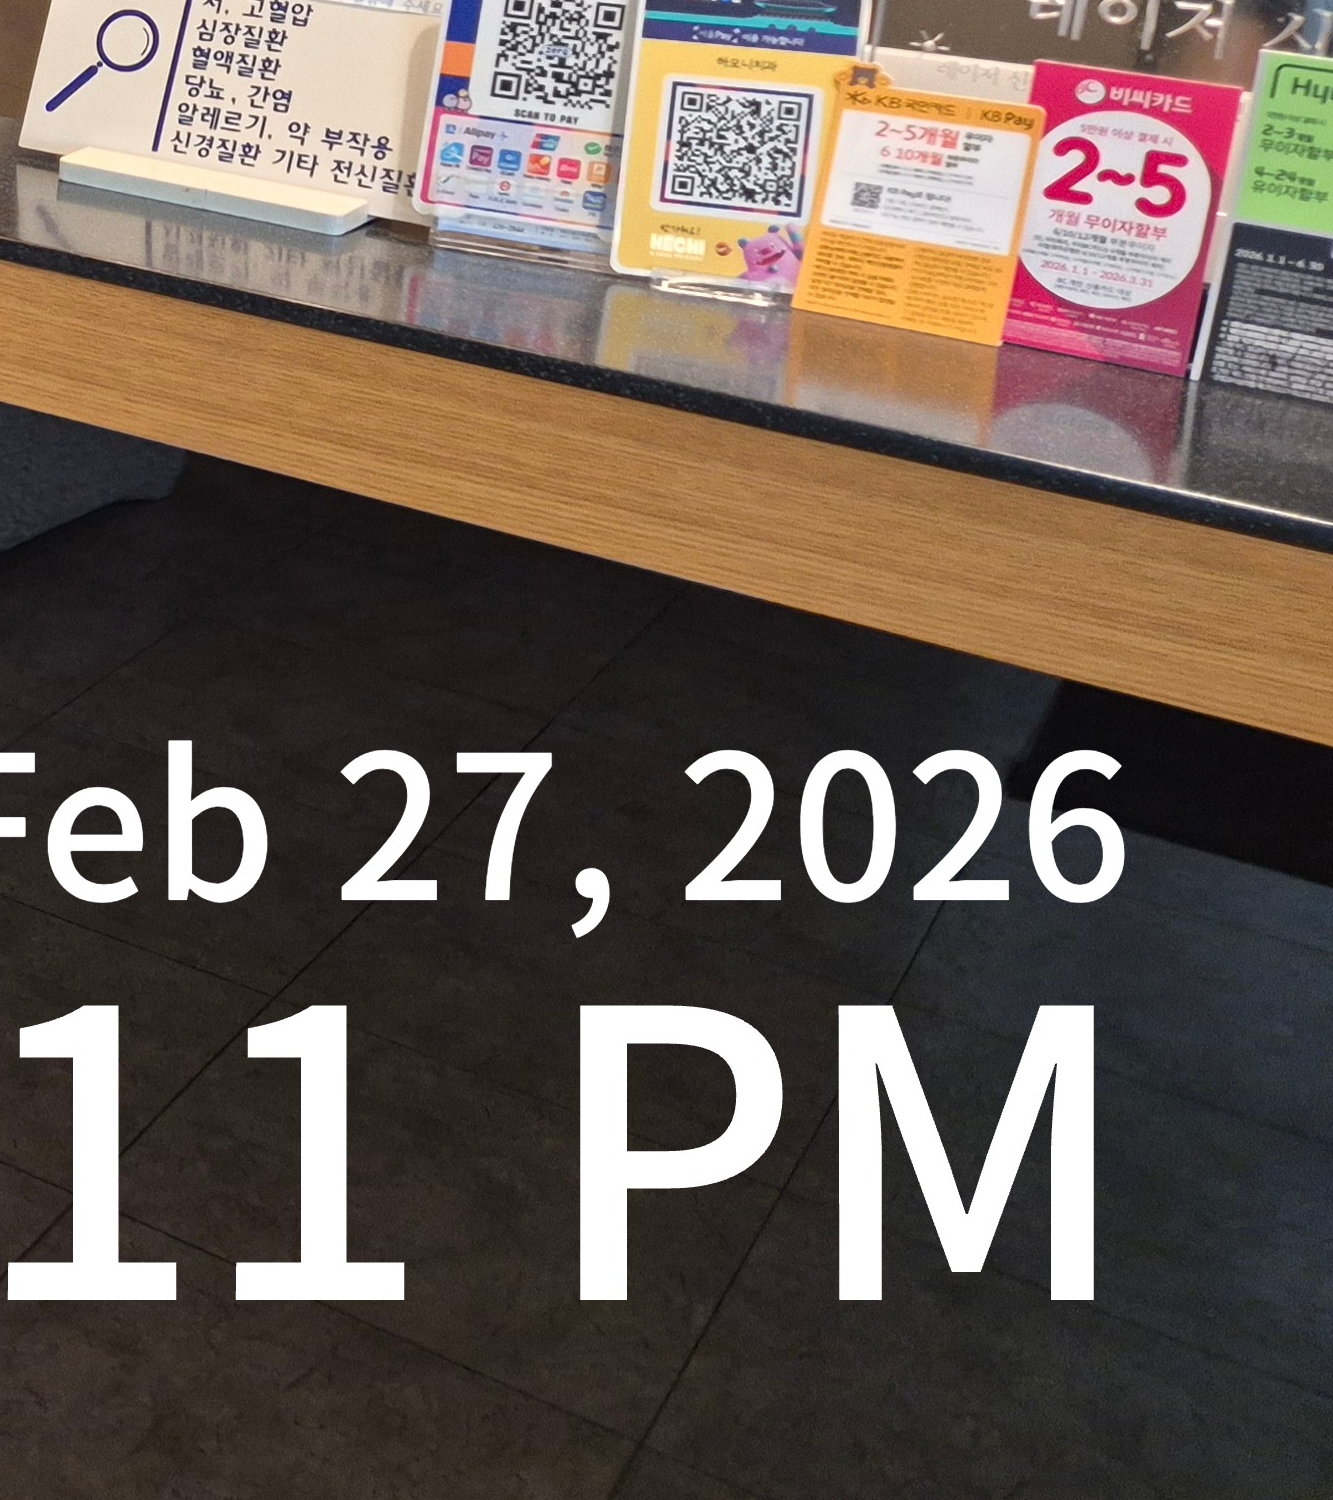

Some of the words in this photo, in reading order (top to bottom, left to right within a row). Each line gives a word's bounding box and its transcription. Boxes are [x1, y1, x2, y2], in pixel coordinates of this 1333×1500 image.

[195, 18, 289, 53] 심장질환
[191, 46, 282, 82] 혈액질환
[248, 83, 294, 114] 간염
[1109, 86, 1193, 114] 비씨카드
[513, 108, 541, 121] SCAN
[544, 112, 557, 122] TO
[559, 114, 580, 126] PAY
[1002, 111, 1035, 131] Pay
[287, 120, 312, 145] 약
[320, 127, 394, 161] 부작용
[874, 119, 960, 151] 2~5개월
[169, 132, 263, 168] 신경질환
[273, 148, 320, 178] 기타
[1043, 135, 1190, 219] 2~5
[1048, 208, 1081, 227] 개월
[1084, 213, 1168, 242] 무이자할부
